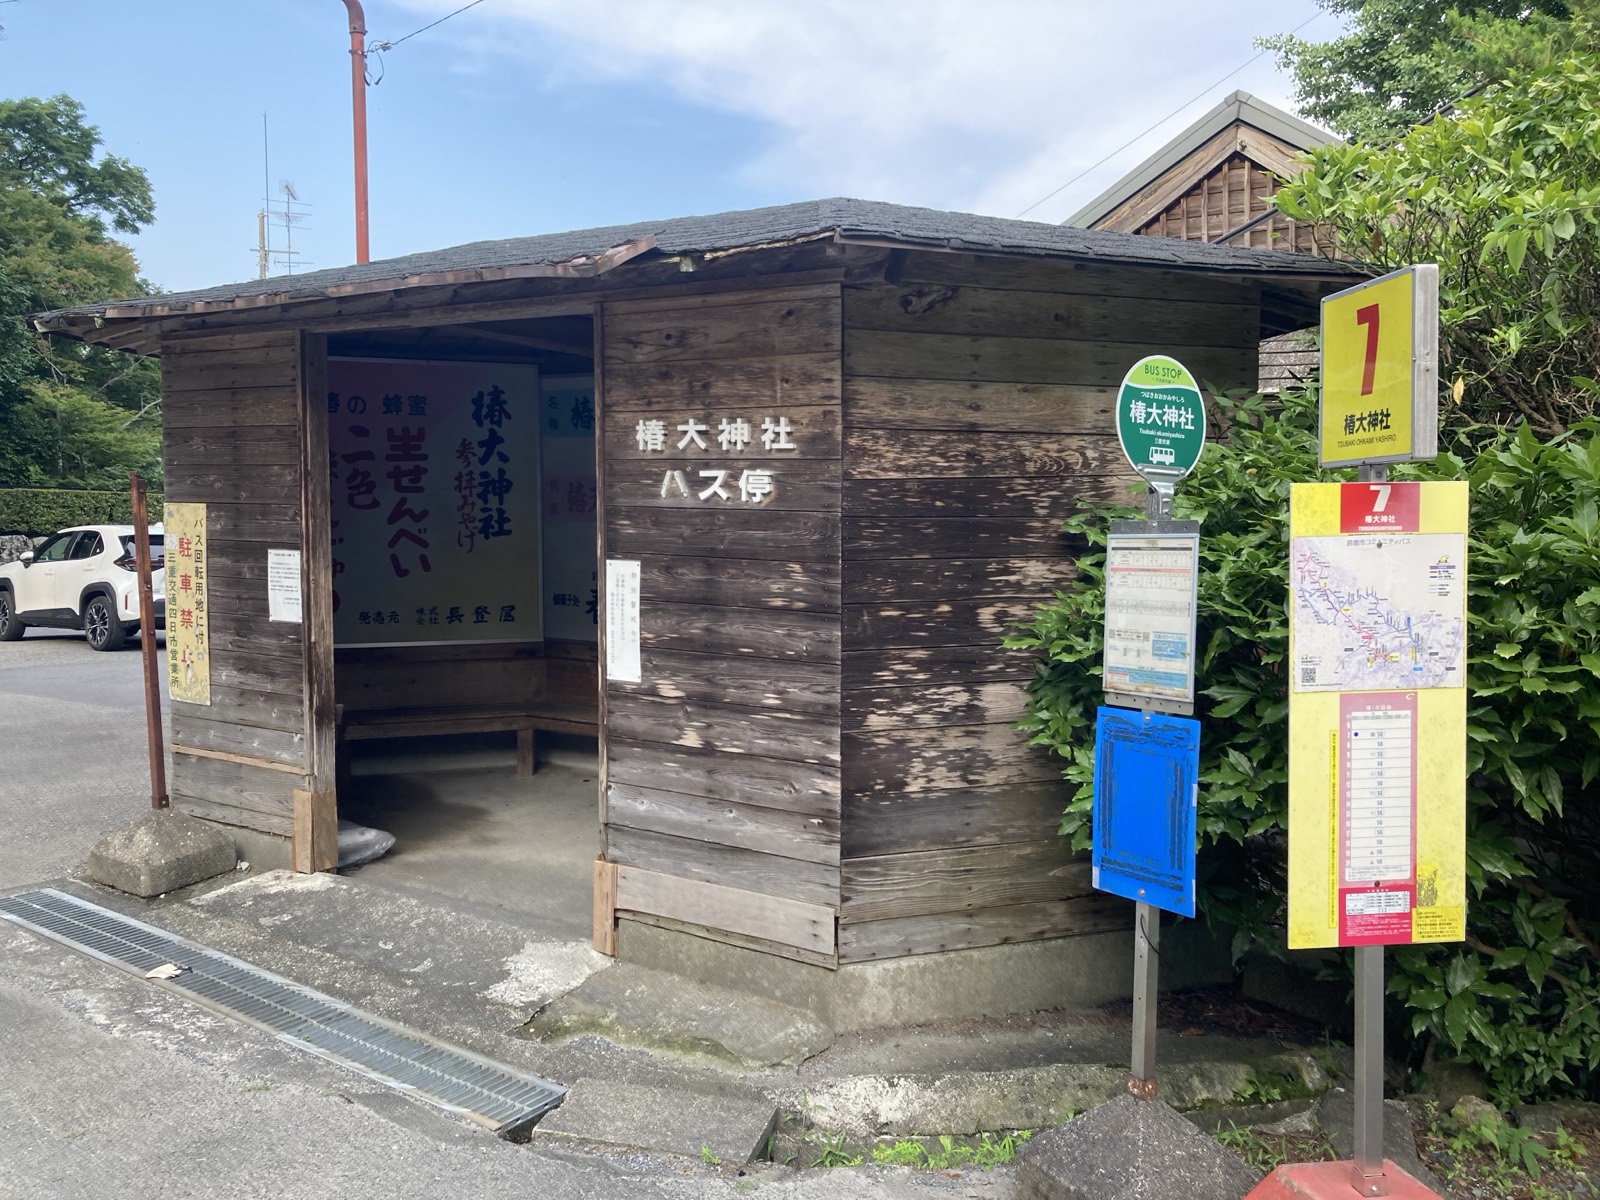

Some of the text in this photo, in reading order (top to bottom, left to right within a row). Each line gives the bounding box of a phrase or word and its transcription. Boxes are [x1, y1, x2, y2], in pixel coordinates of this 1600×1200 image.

[1356, 303, 1380, 397] 7
[1144, 364, 1182, 379] BUS STOP
[382, 394, 428, 417] 蜂蜜
[1140, 391, 1185, 403] つばきおおかみやしろ
[1129, 399, 1195, 430] 椿大神社
[1343, 407, 1391, 436] 椿大神社
[635, 417, 797, 451] 椿大神社
[1337, 433, 1397, 448] TSUBAKI OHKAMI YASHIRO
[471, 384, 514, 541] 椿大神社
[384, 426, 432, 578] 生せんべい
[453, 437, 479, 554] 参拝みやげ
[1369, 484, 1392, 512] 7
[1364, 514, 1396, 524] 椿大神社
[194, 518, 205, 645] バス回転用地に付
[178, 537, 194, 664] 駐車禁止
[167, 552, 180, 689] 三重交通四日市営業所
[358, 610, 400, 625] 発売元
